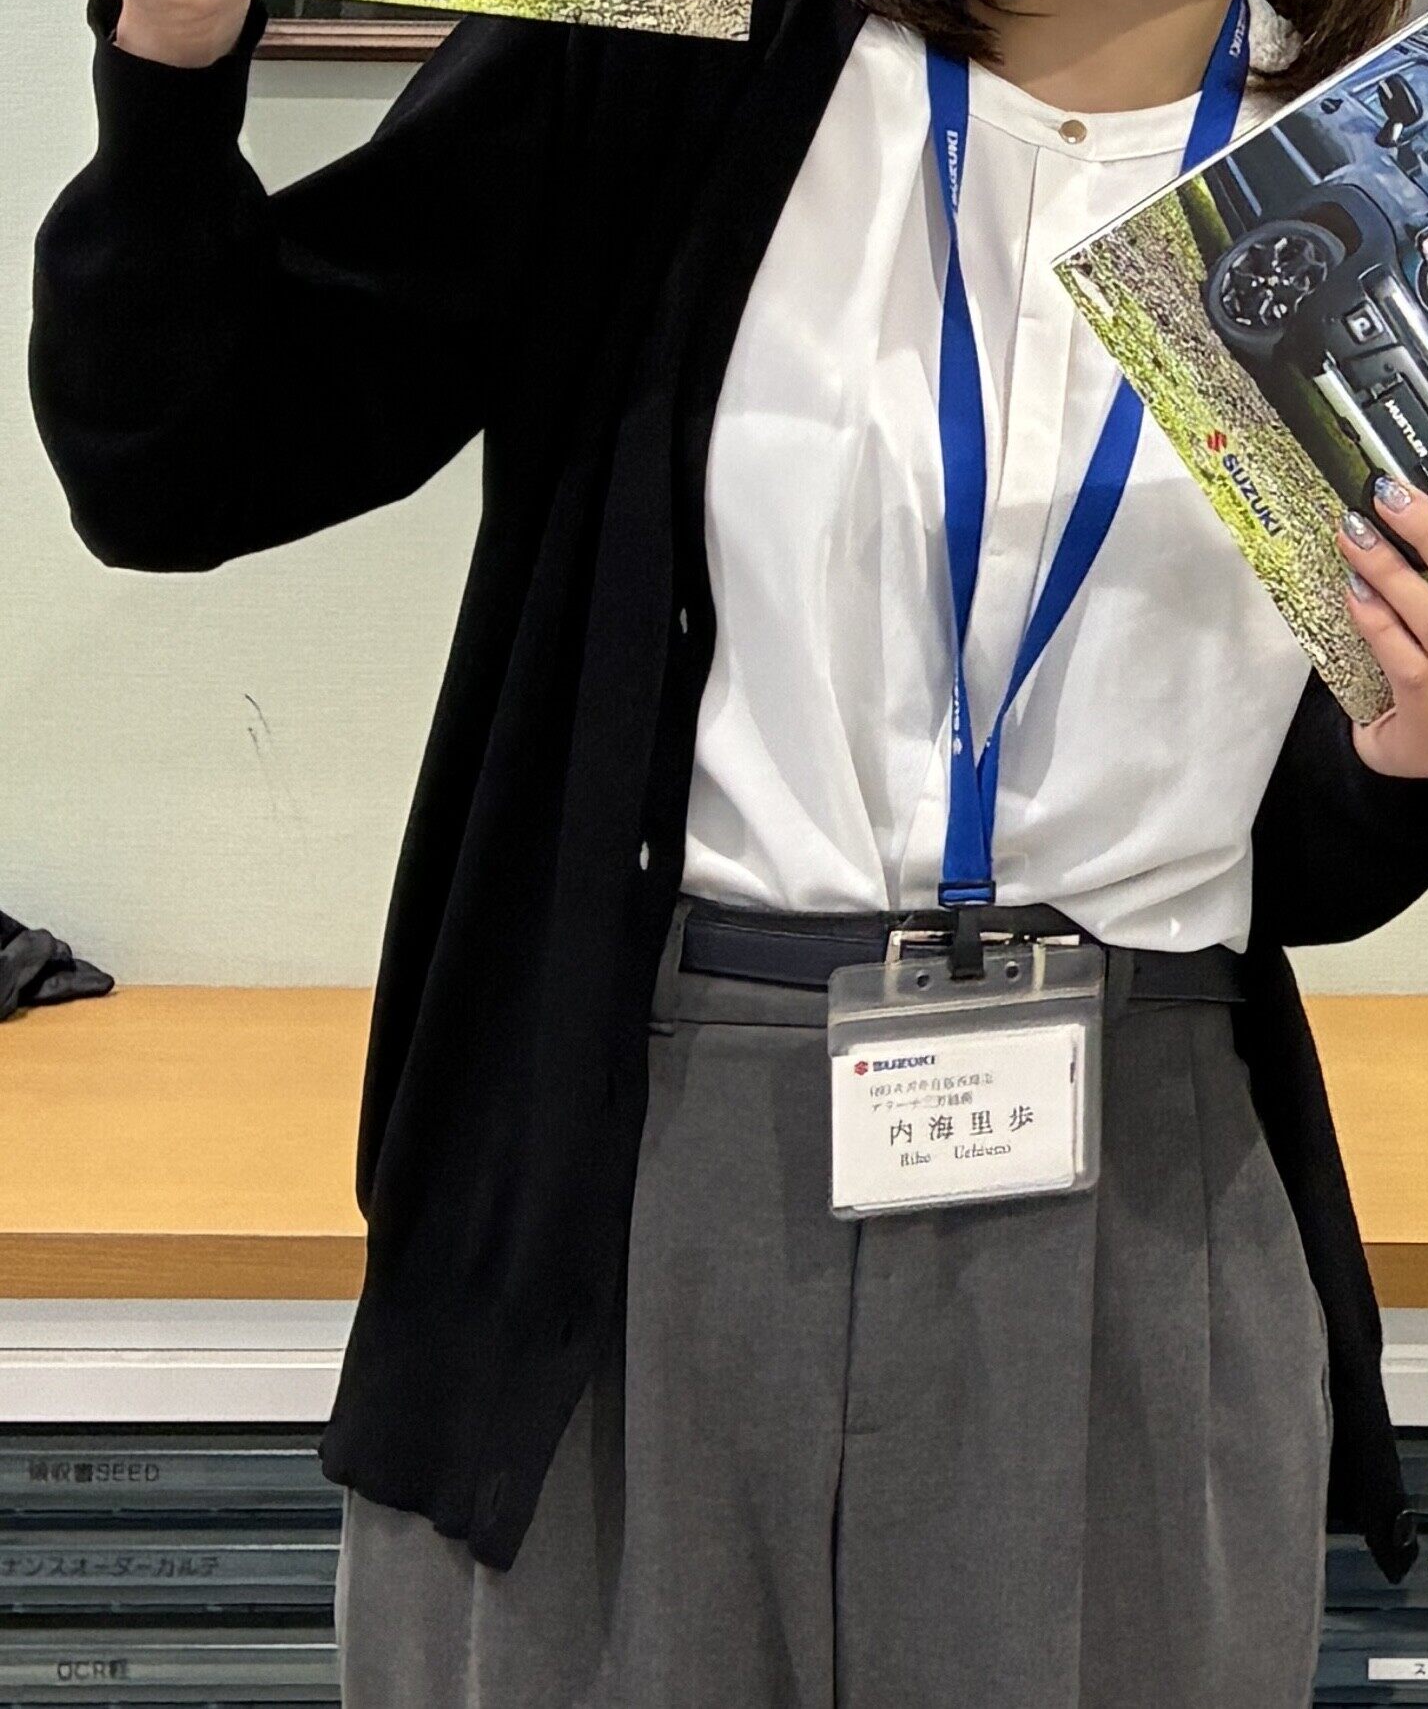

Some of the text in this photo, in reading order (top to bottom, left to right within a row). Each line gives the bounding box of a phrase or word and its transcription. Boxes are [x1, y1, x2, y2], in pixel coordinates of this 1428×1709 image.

[1385, 399, 1428, 458] HUSTLER
[1223, 453, 1283, 537] SUZUKI
[873, 1055, 936, 1072] SUZUKI
